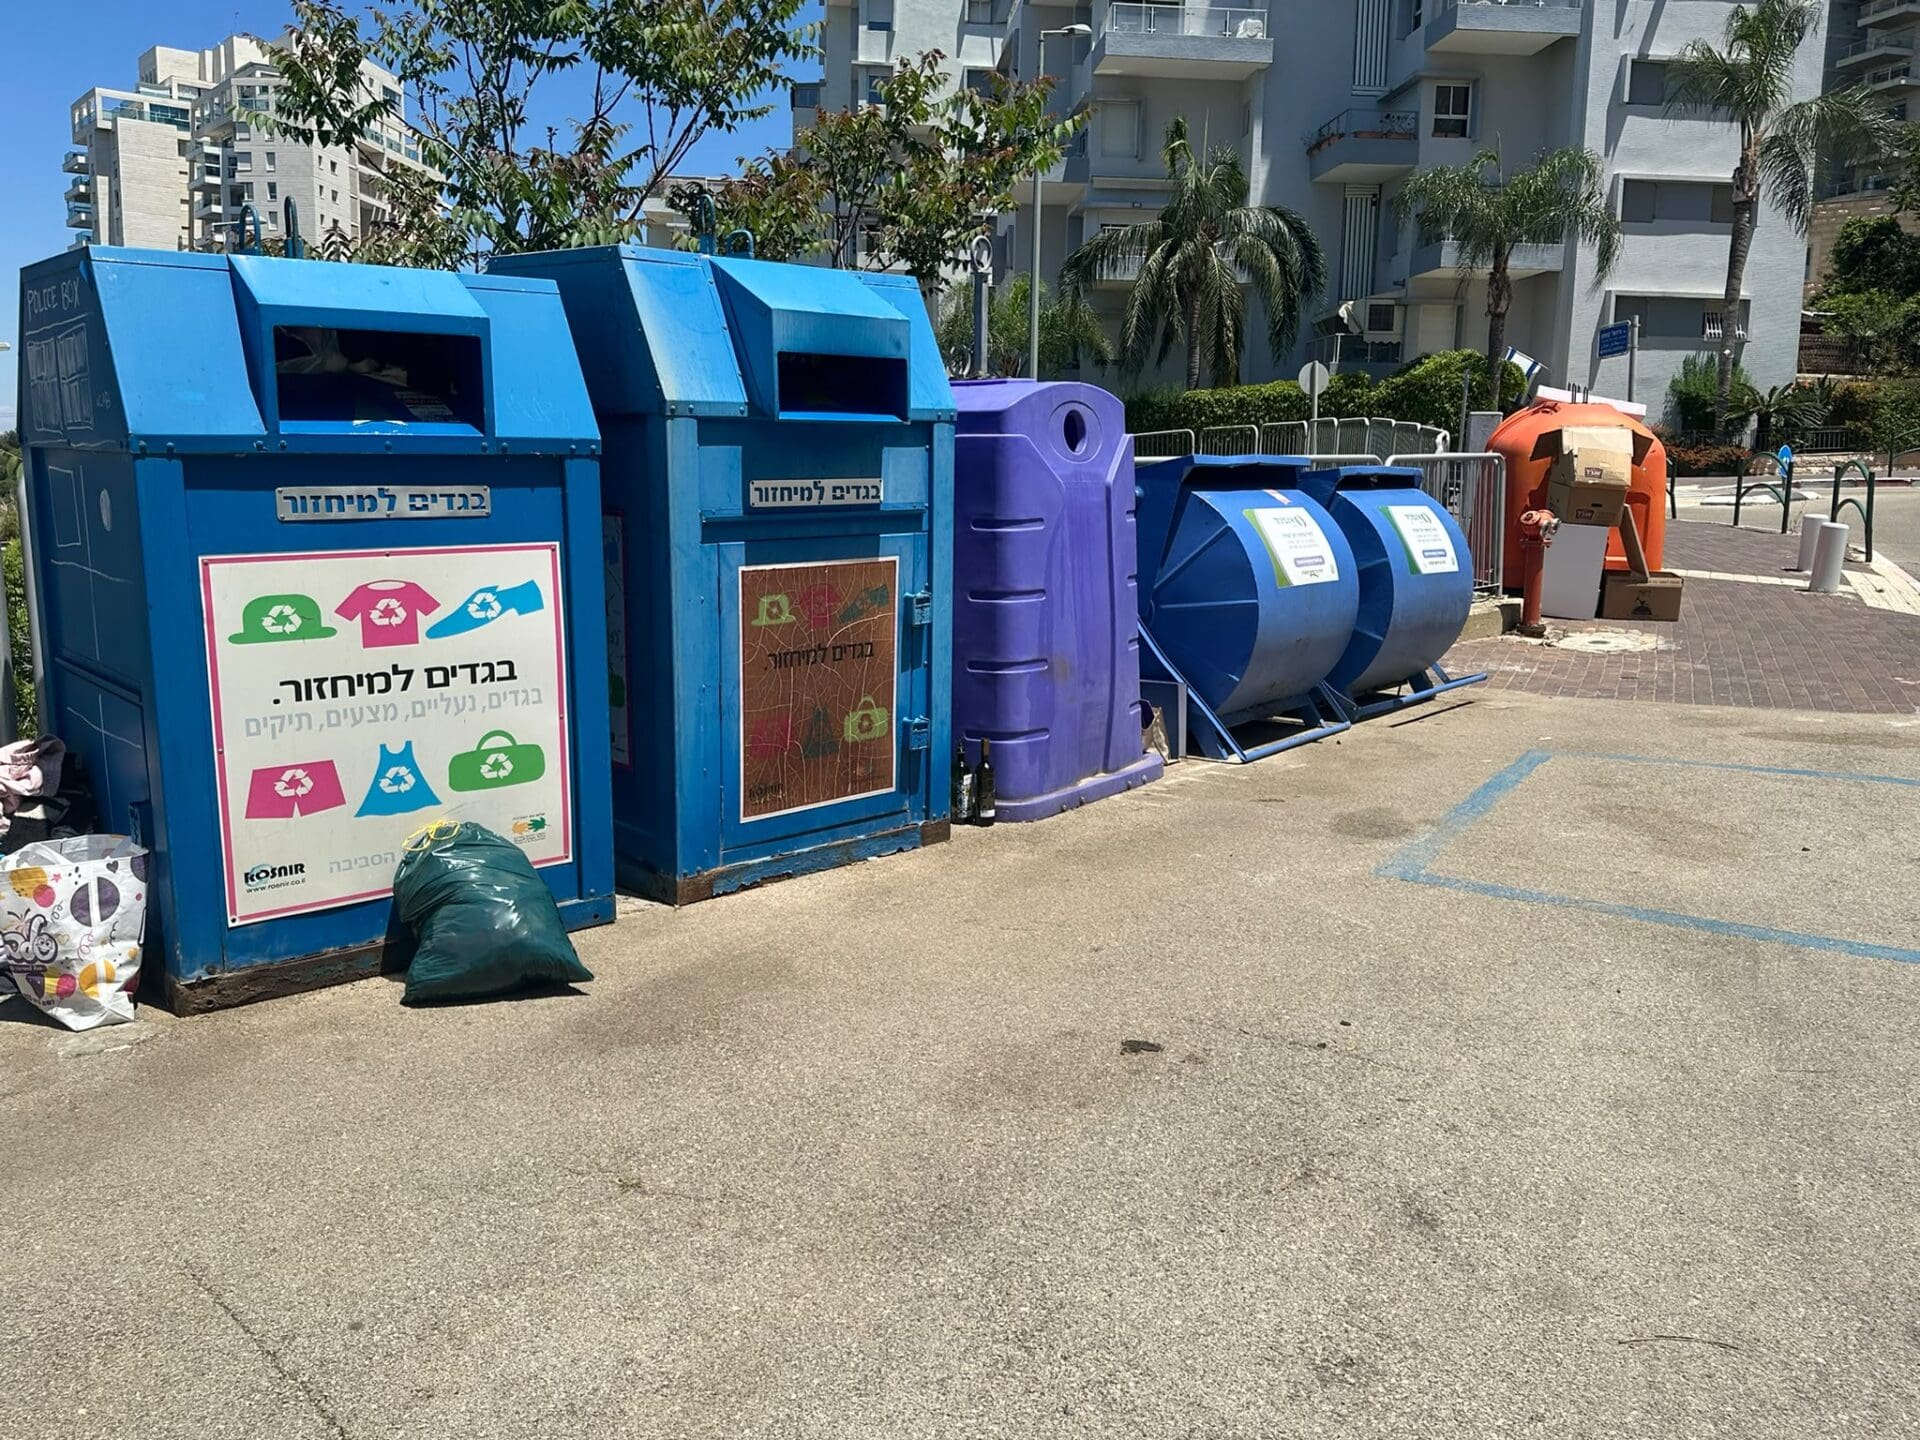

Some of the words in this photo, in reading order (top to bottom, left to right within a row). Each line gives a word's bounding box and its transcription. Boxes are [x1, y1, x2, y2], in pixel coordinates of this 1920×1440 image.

[27, 285, 58, 322] POLICE
[61, 277, 80, 311] BOX
[283, 487, 397, 514] למיחזור
[408, 492, 486, 512] בגדים
[754, 481, 825, 502] למיחזור
[831, 485, 881, 501] בגדים
[832, 642, 874, 661] בגדים
[272, 664, 415, 705] למיחזור.
[423, 659, 518, 689] בגדים
[404, 692, 476, 722] נעליים,
[481, 687, 543, 713] בגדים,
[244, 711, 313, 740] תיקים
[318, 701, 399, 732] מצעים,
[244, 863, 305, 885] ROSNIR
[329, 852, 396, 874] הסביבה
[246, 877, 307, 894] www.rosnir.co.il
